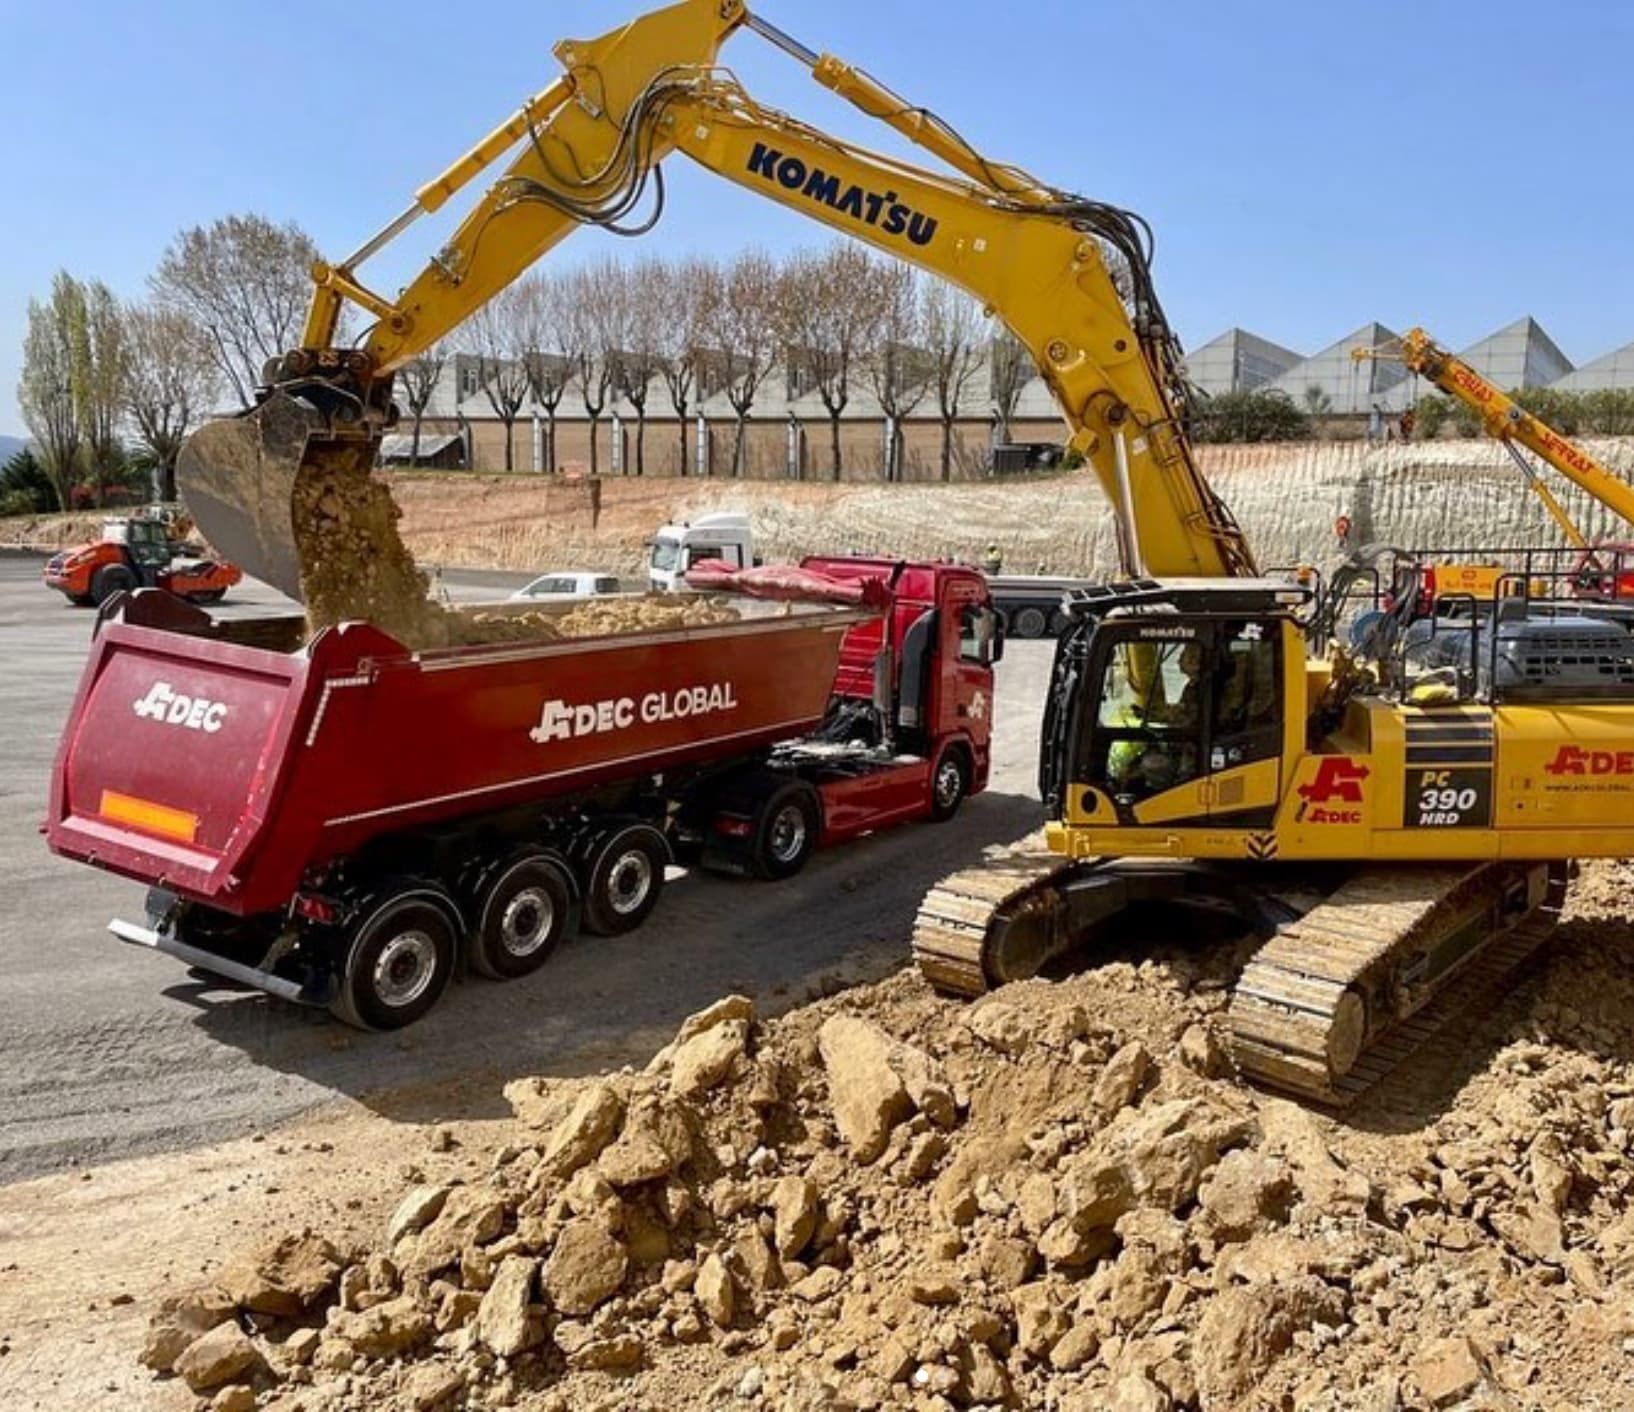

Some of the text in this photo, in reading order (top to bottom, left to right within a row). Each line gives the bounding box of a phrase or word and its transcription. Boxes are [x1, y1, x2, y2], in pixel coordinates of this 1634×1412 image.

[746, 141, 939, 246] KOMATSU
[133, 680, 228, 734] ADEC
[529, 682, 738, 744] ADEC GLOBAL
[1420, 771, 1451, 787] PC
[1419, 788, 1477, 810] 390
[1307, 808, 1361, 823] ADEC
[1419, 812, 1460, 825] HRD
